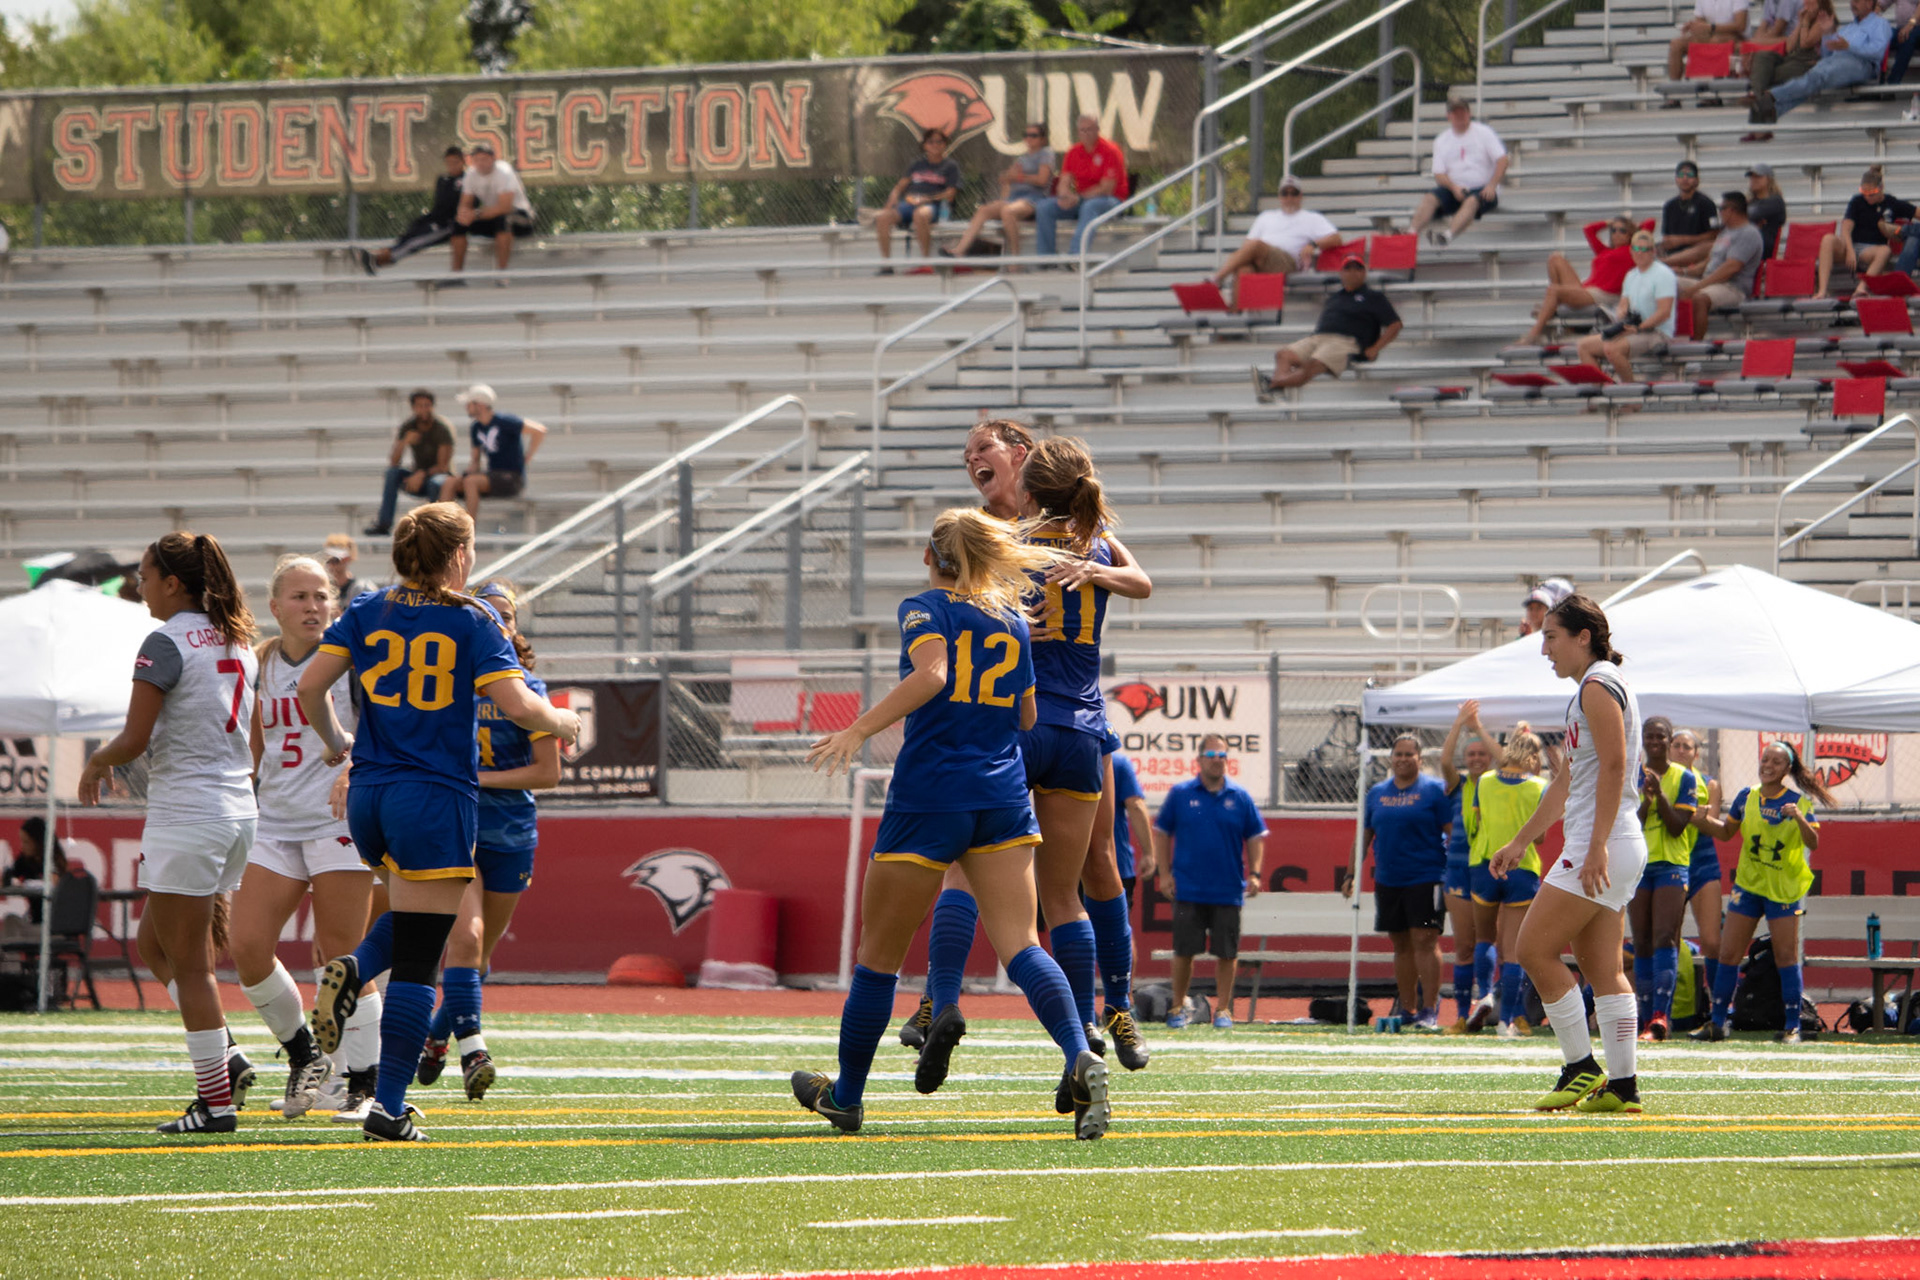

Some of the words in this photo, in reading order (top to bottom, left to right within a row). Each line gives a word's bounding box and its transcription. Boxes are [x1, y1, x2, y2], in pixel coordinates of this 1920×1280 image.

[53, 94, 432, 191] STUDENT
[457, 79, 813, 177] SECTION
[979, 69, 1164, 156] UIW
[1044, 581, 1096, 645] 11
[216, 658, 245, 733] 7
[360, 629, 457, 711] 28
[949, 629, 1021, 708] 12
[1158, 685, 1237, 720] UIW
[281, 732, 304, 768] 5
[1124, 733, 1260, 752] OKSTRE
